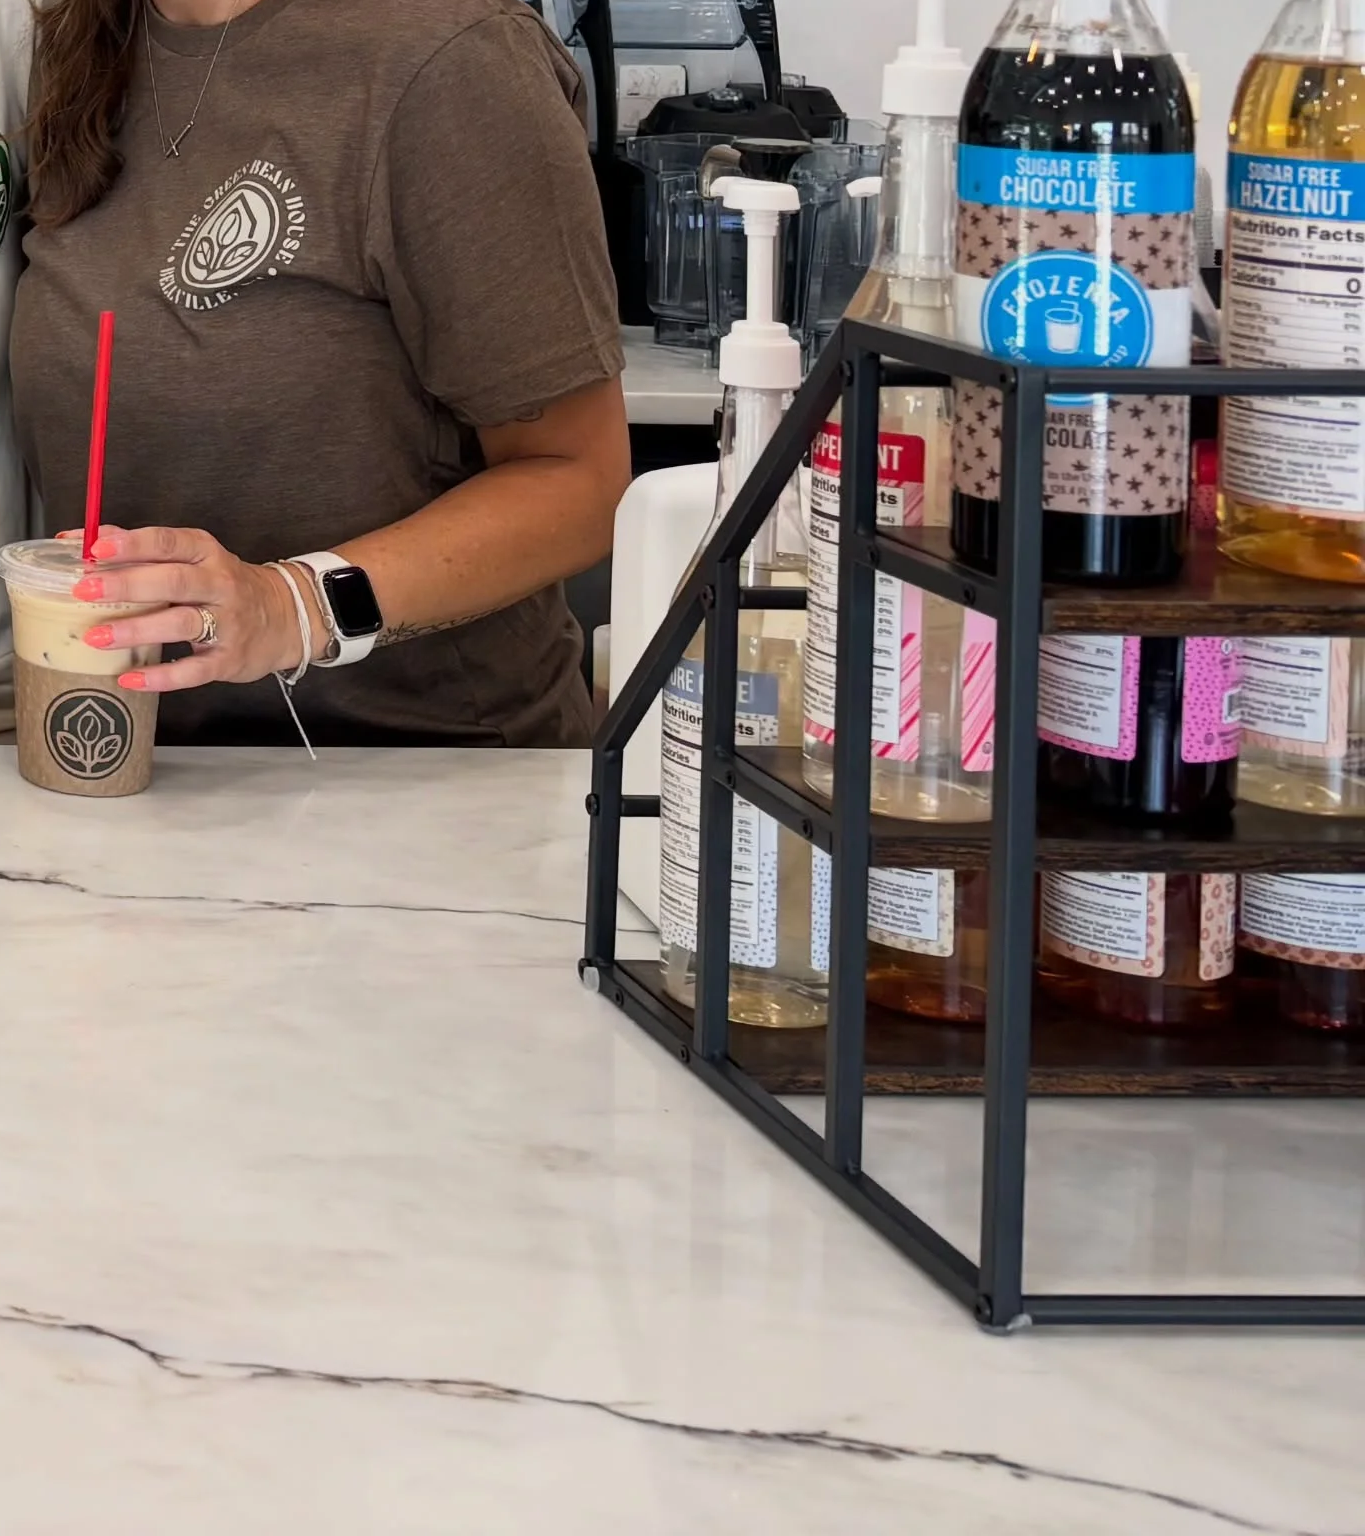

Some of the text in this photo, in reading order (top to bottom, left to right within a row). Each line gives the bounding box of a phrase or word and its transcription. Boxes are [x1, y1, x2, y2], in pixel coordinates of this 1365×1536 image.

[1015, 157, 1120, 180] SUGAR FREE
[1248, 162, 1342, 188] SUGAR FREE
[1000, 175, 1136, 208] CHOCOLATE
[1240, 181, 1353, 217] HAZELNUT
[170, 214, 201, 251] THE
[249, 159, 296, 195] BEAN
[275, 196, 306, 265] HOUSE
[1232, 216, 1365, 243] Nutrition Facts
[1346, 278, 1361, 294] 0
